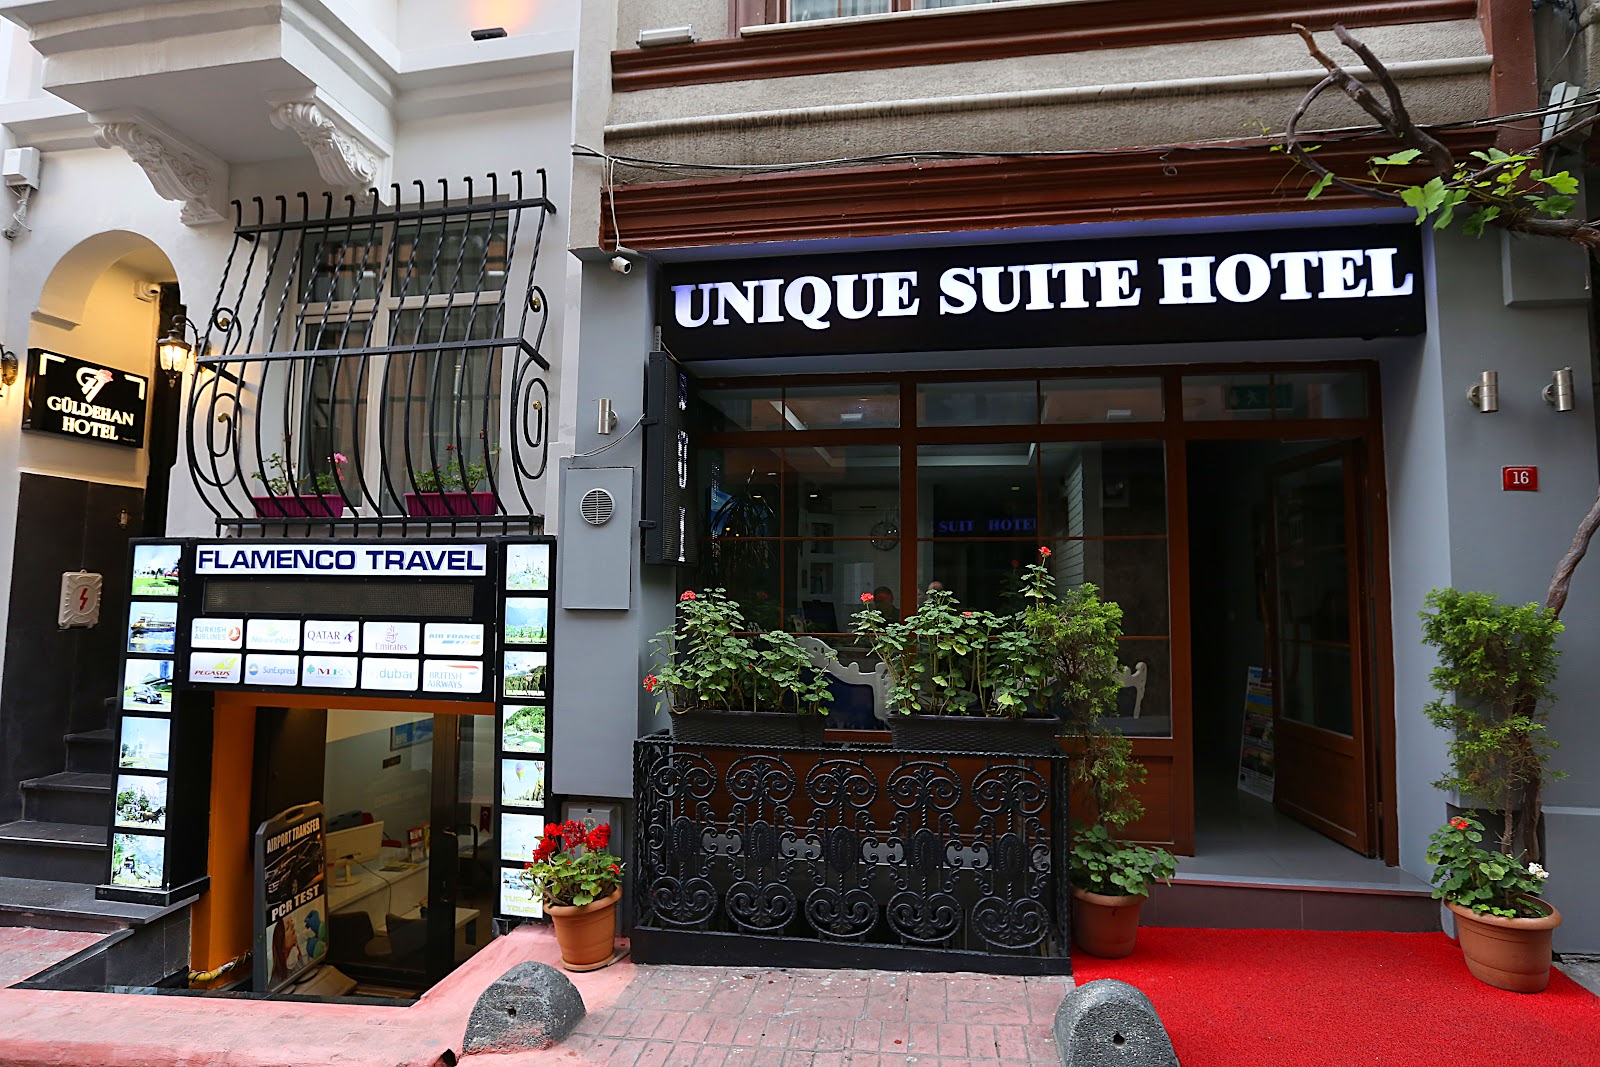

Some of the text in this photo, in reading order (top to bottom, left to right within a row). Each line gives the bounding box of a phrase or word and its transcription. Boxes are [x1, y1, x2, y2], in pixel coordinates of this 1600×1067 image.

[671, 248, 1413, 329] UNIQUE SUITE HOTEL
[47, 396, 134, 426] GÜLDEHAN
[62, 416, 118, 440] HOTEL
[1513, 471, 1529, 484] 16
[939, 520, 974, 532] SUIT
[198, 550, 483, 571] FLAMENCO TRAVEL
[194, 626, 227, 634] TURKISH
[307, 630, 341, 641] QATAR
[194, 633, 227, 641] AIRLINES
[251, 635, 297, 644] Nouvelair
[375, 642, 408, 651] Emirates
[263, 666, 296, 676] SunExpress
[429, 671, 462, 680] BRITISH
[427, 679, 463, 689] AIRWAYS
[266, 818, 320, 854] AIRPORT TRANSFER
[271, 884, 320, 922] PCR TEST
[507, 905, 537, 914] TOURS
